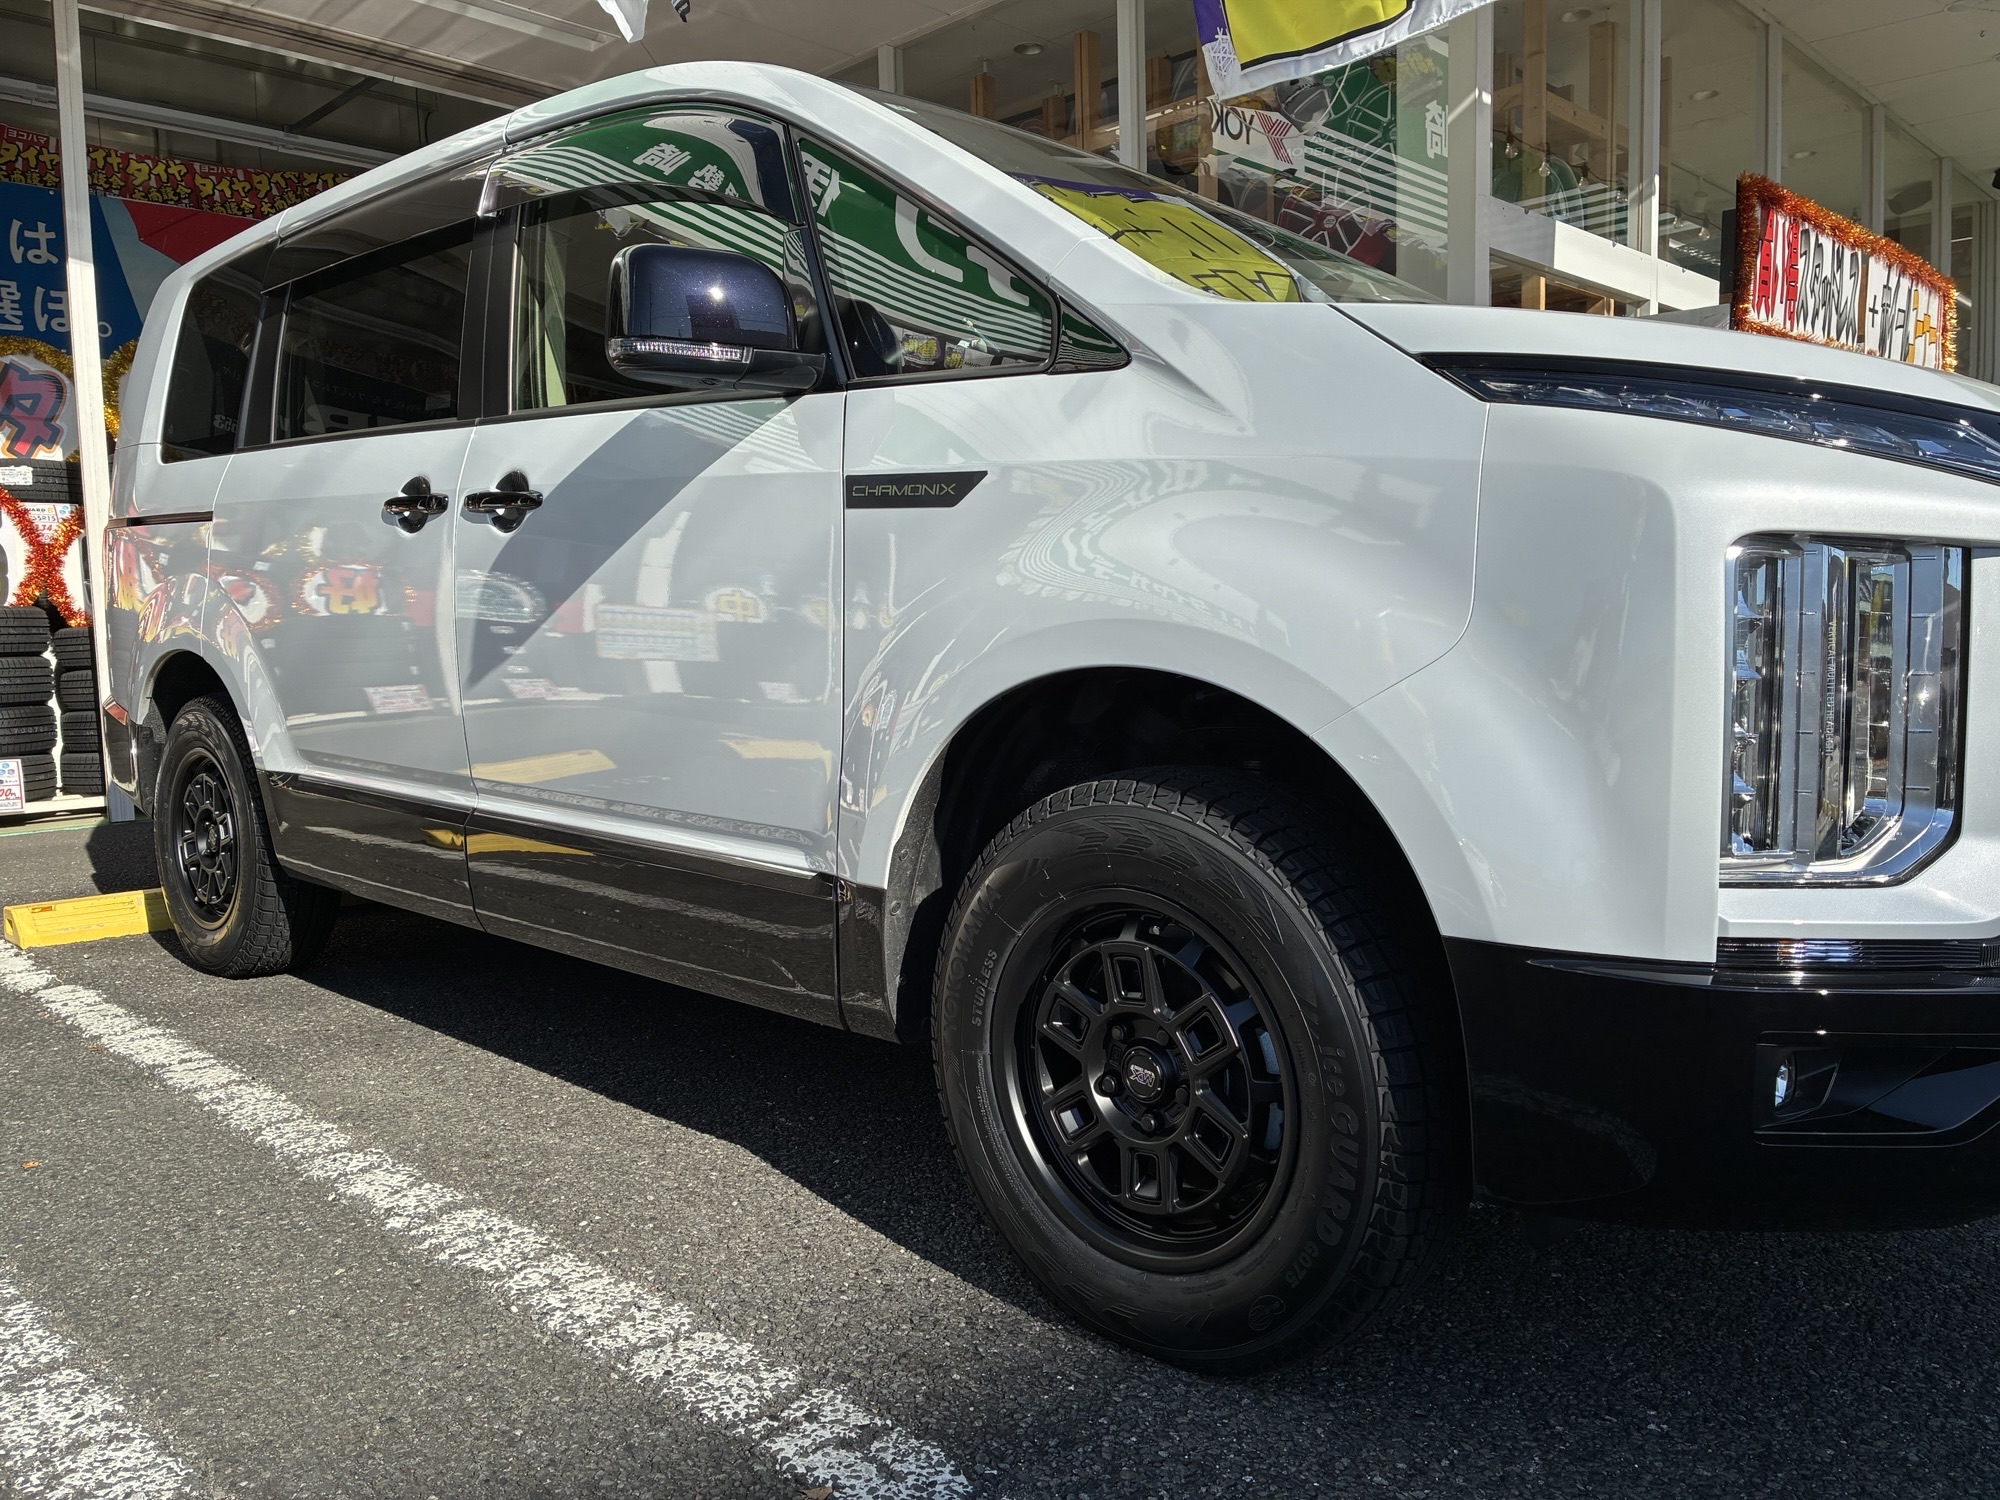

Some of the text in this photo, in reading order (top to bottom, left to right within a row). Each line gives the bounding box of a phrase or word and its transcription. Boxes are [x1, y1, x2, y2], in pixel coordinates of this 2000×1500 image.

[7, 128, 49, 144] ヨコハマ
[126, 158, 188, 186] タイヤ
[195, 172, 252, 199] タイヤ
[9, 218, 60, 265] は
[851, 481, 957, 498] CHAMONIX
[1825, 620, 1837, 761] VERTICAL MULTI LED HEADLIGHT
[942, 883, 1003, 1033] YOKOHAMA
[970, 948, 999, 1027] STUDLESS
